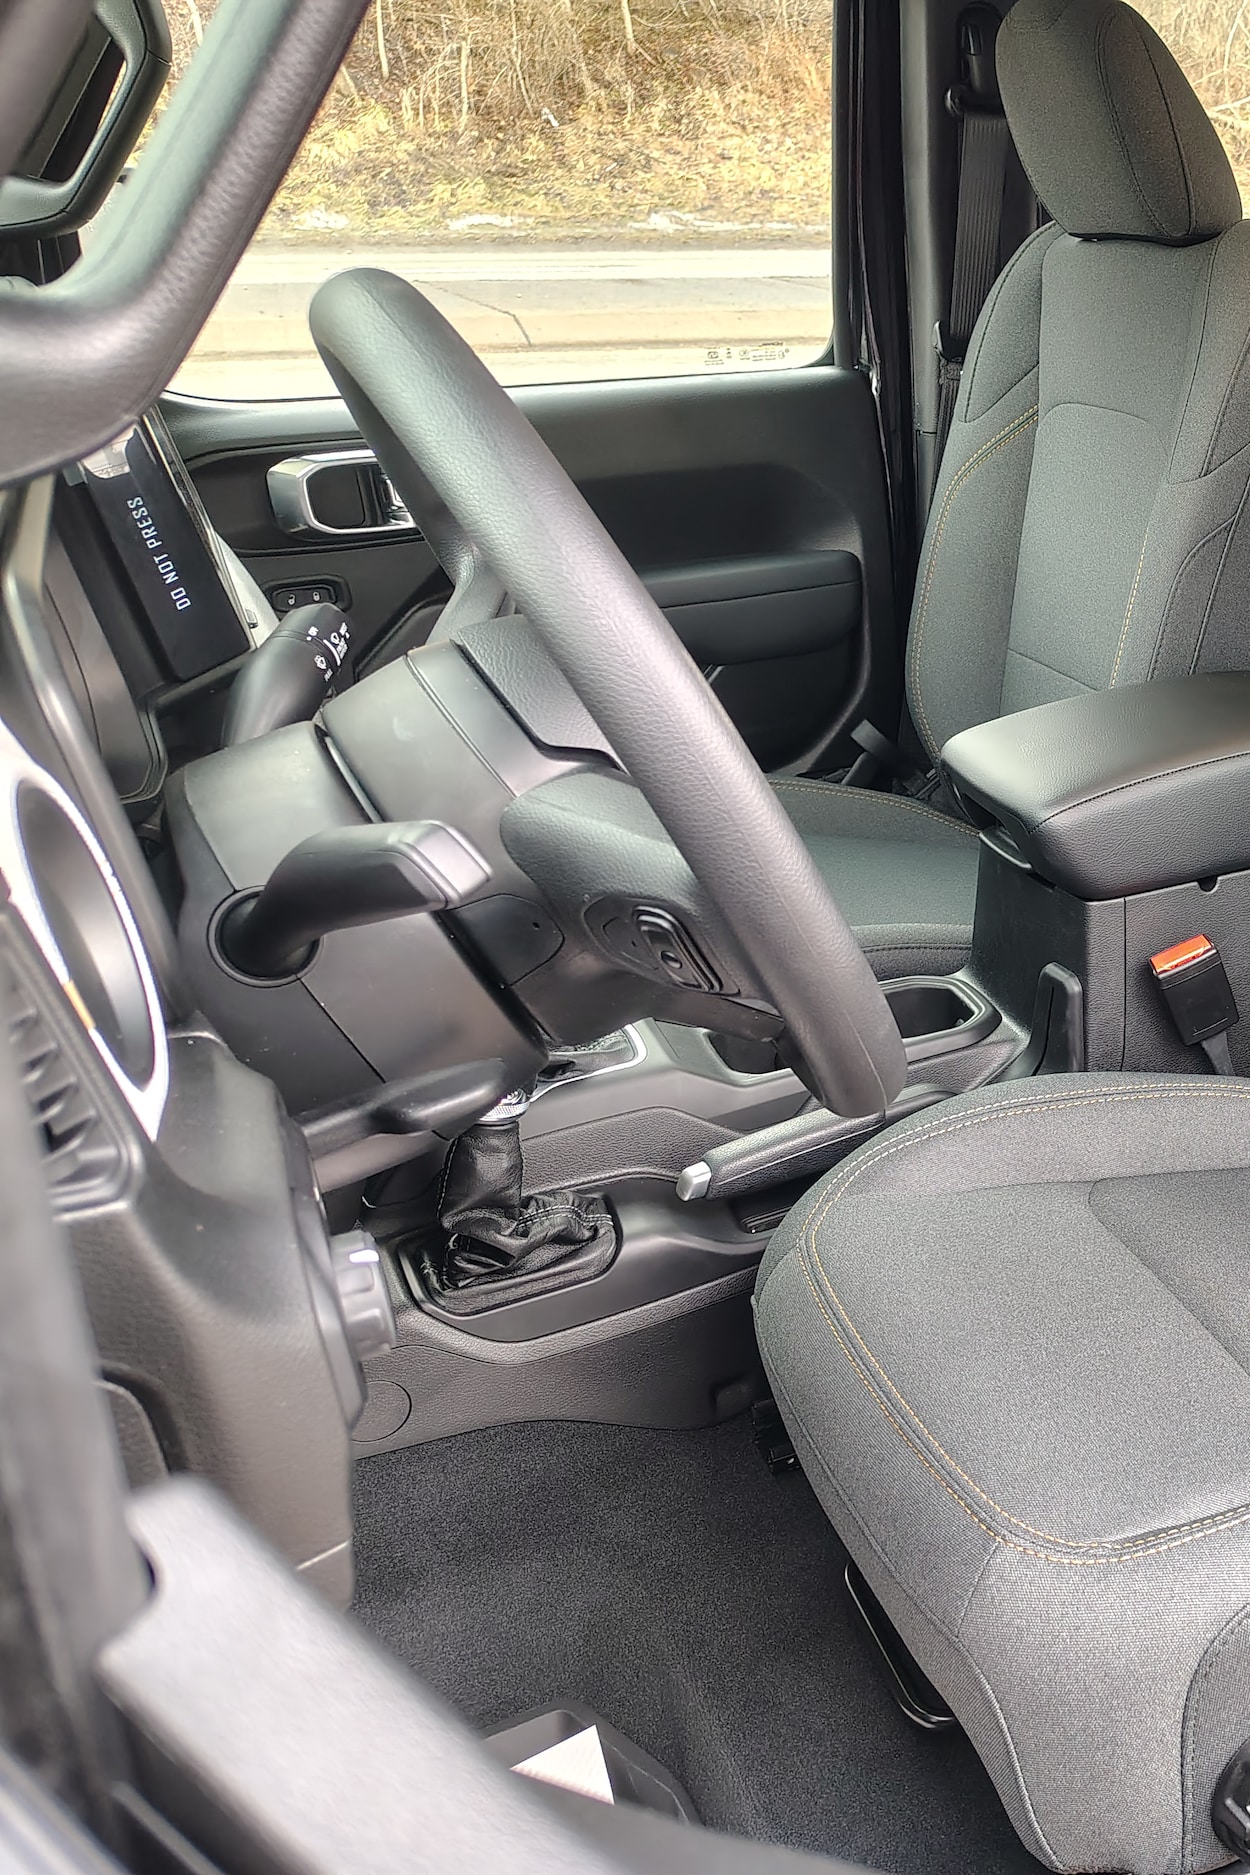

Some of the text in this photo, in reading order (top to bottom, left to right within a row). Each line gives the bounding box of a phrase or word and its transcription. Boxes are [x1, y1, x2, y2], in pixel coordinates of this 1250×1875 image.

[126, 496, 191, 610] DO NOT PRESS
